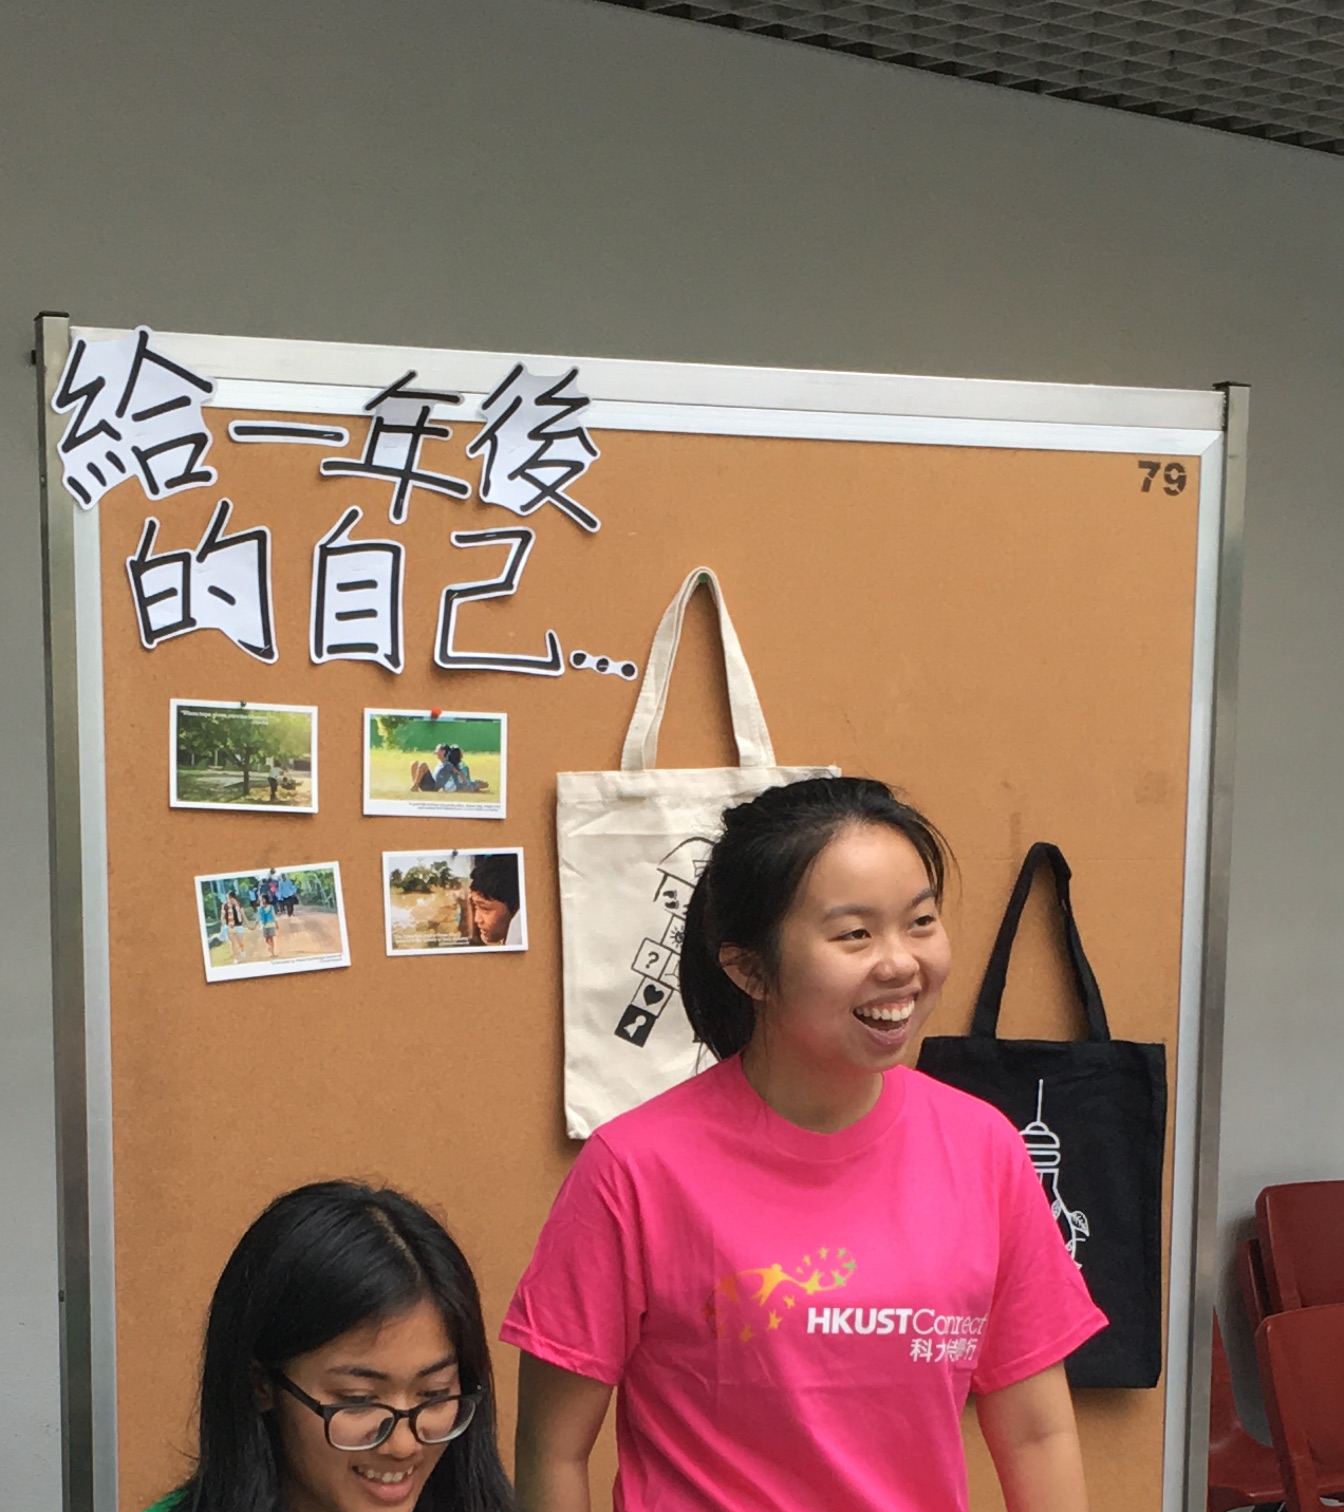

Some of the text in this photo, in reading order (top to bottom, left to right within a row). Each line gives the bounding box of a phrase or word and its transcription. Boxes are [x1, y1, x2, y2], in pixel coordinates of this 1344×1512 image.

[54, 329, 599, 531] 給一年後
[1138, 460, 1187, 496] 79
